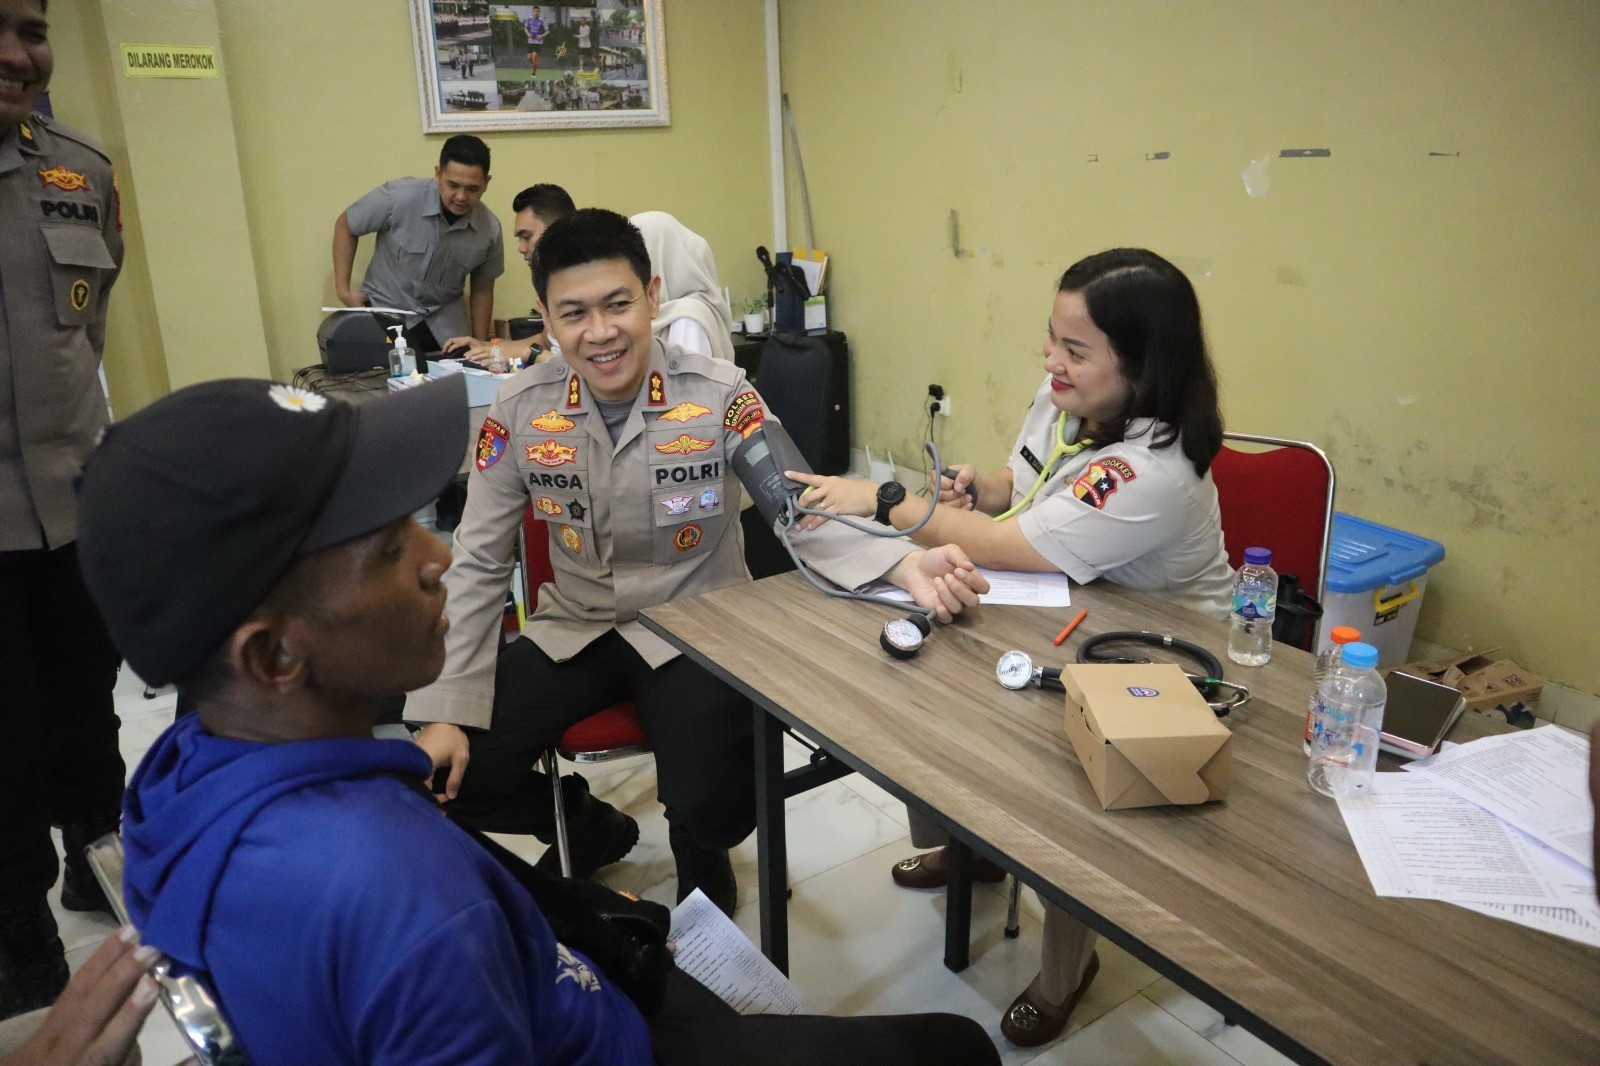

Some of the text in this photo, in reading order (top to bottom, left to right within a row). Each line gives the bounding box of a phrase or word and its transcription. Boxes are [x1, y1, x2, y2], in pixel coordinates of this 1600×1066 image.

[127, 52, 215, 69] DILARANG MEROKOK
[725, 393, 755, 426] POLRES
[529, 472, 583, 490] ARGA
[655, 461, 719, 485] POLRI
